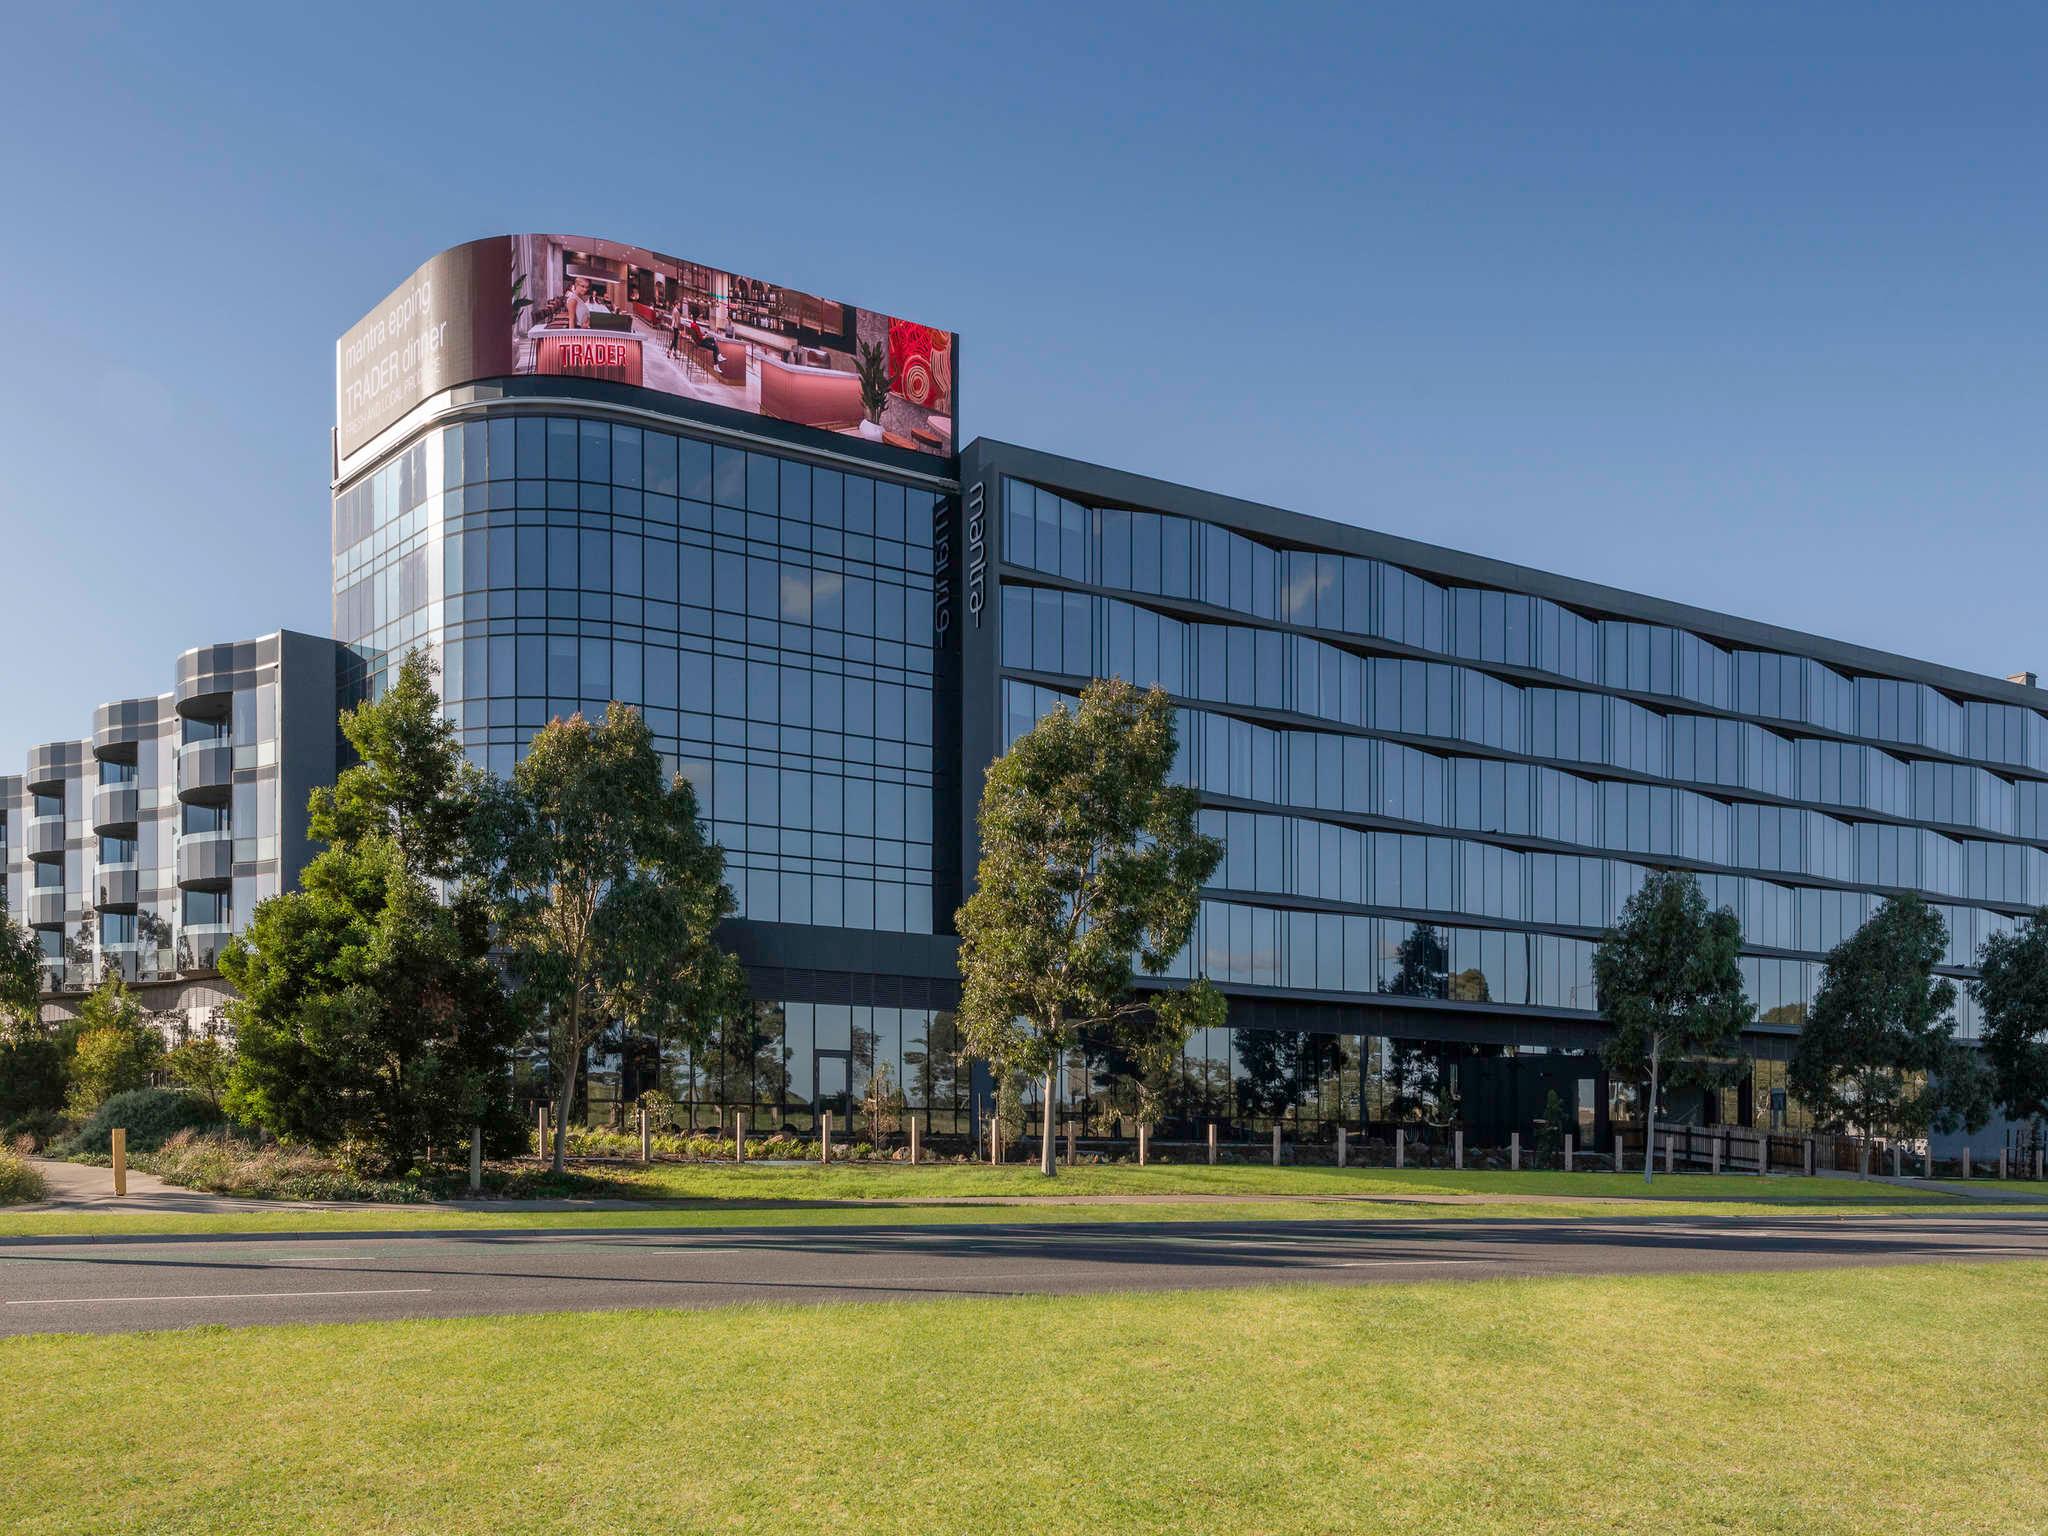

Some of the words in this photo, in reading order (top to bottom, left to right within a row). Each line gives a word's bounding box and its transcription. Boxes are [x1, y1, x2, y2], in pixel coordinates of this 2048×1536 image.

[345, 319, 385, 369] mantra
[388, 280, 431, 338] epping
[345, 350, 399, 415] TRADER
[402, 321, 447, 371] dinner
[559, 343, 629, 367] TRADER
[969, 480, 987, 631] mantra
